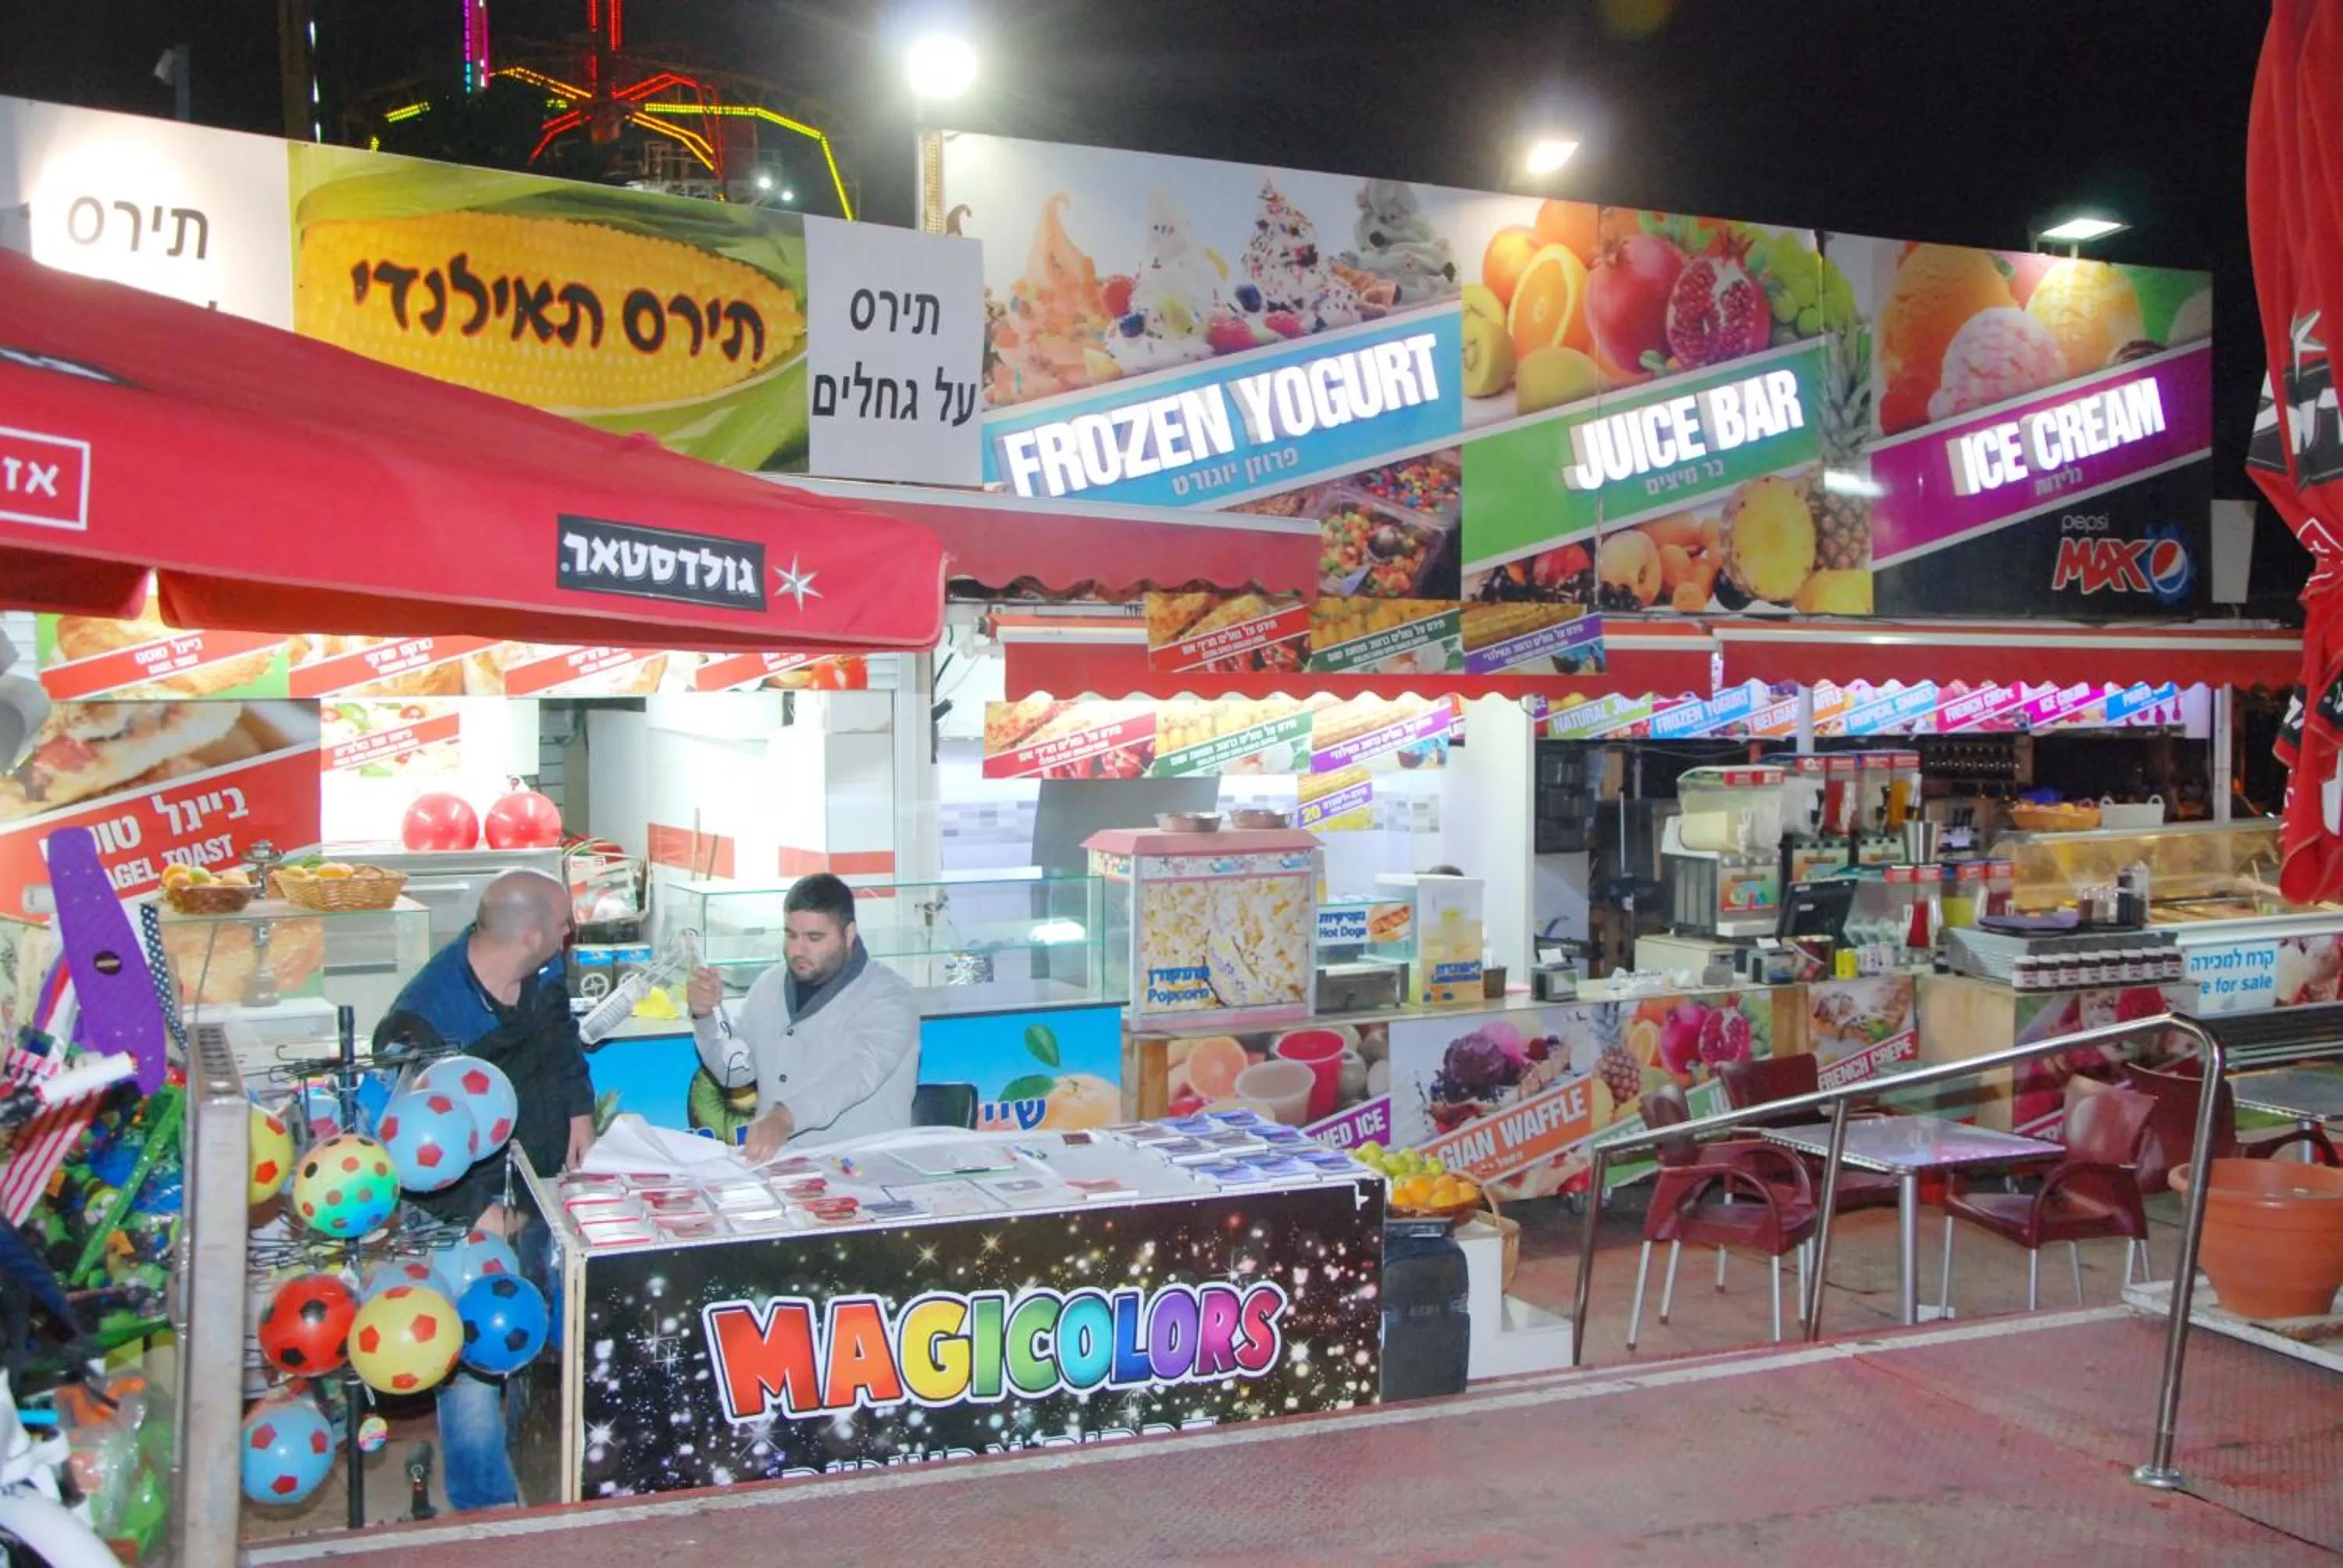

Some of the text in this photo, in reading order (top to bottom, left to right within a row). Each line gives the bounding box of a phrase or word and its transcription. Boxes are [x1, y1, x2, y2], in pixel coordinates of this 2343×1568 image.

[67, 195, 210, 260] תירס
[351, 251, 766, 362] תירס תאילנדי
[849, 288, 940, 336] תירס
[811, 361, 976, 427] על גחלים
[1000, 333, 1439, 498] FROZEN YOGURT
[1565, 369, 1804, 491] JUICE BAR
[1948, 422, 2029, 496] ICE
[2025, 376, 2166, 470] CREAM
[2, 456, 60, 497] אז
[2061, 513, 2109, 533] pepsi
[561, 531, 761, 597] גולדסטאר
[2051, 536, 2154, 595] MAX
[162, 834, 234, 868] TOAST
[1318, 927, 1339, 938] Hot
[1147, 987, 1210, 1006] Popcorn
[2215, 977, 2238, 993] for
[2241, 974, 2273, 992] sale
[1354, 1107, 1387, 1139] ICE
[1435, 1127, 1497, 1172] GIAN
[1499, 1086, 1589, 1150] WAFFLE
[704, 1282, 1287, 1423] MAGICOLORS
